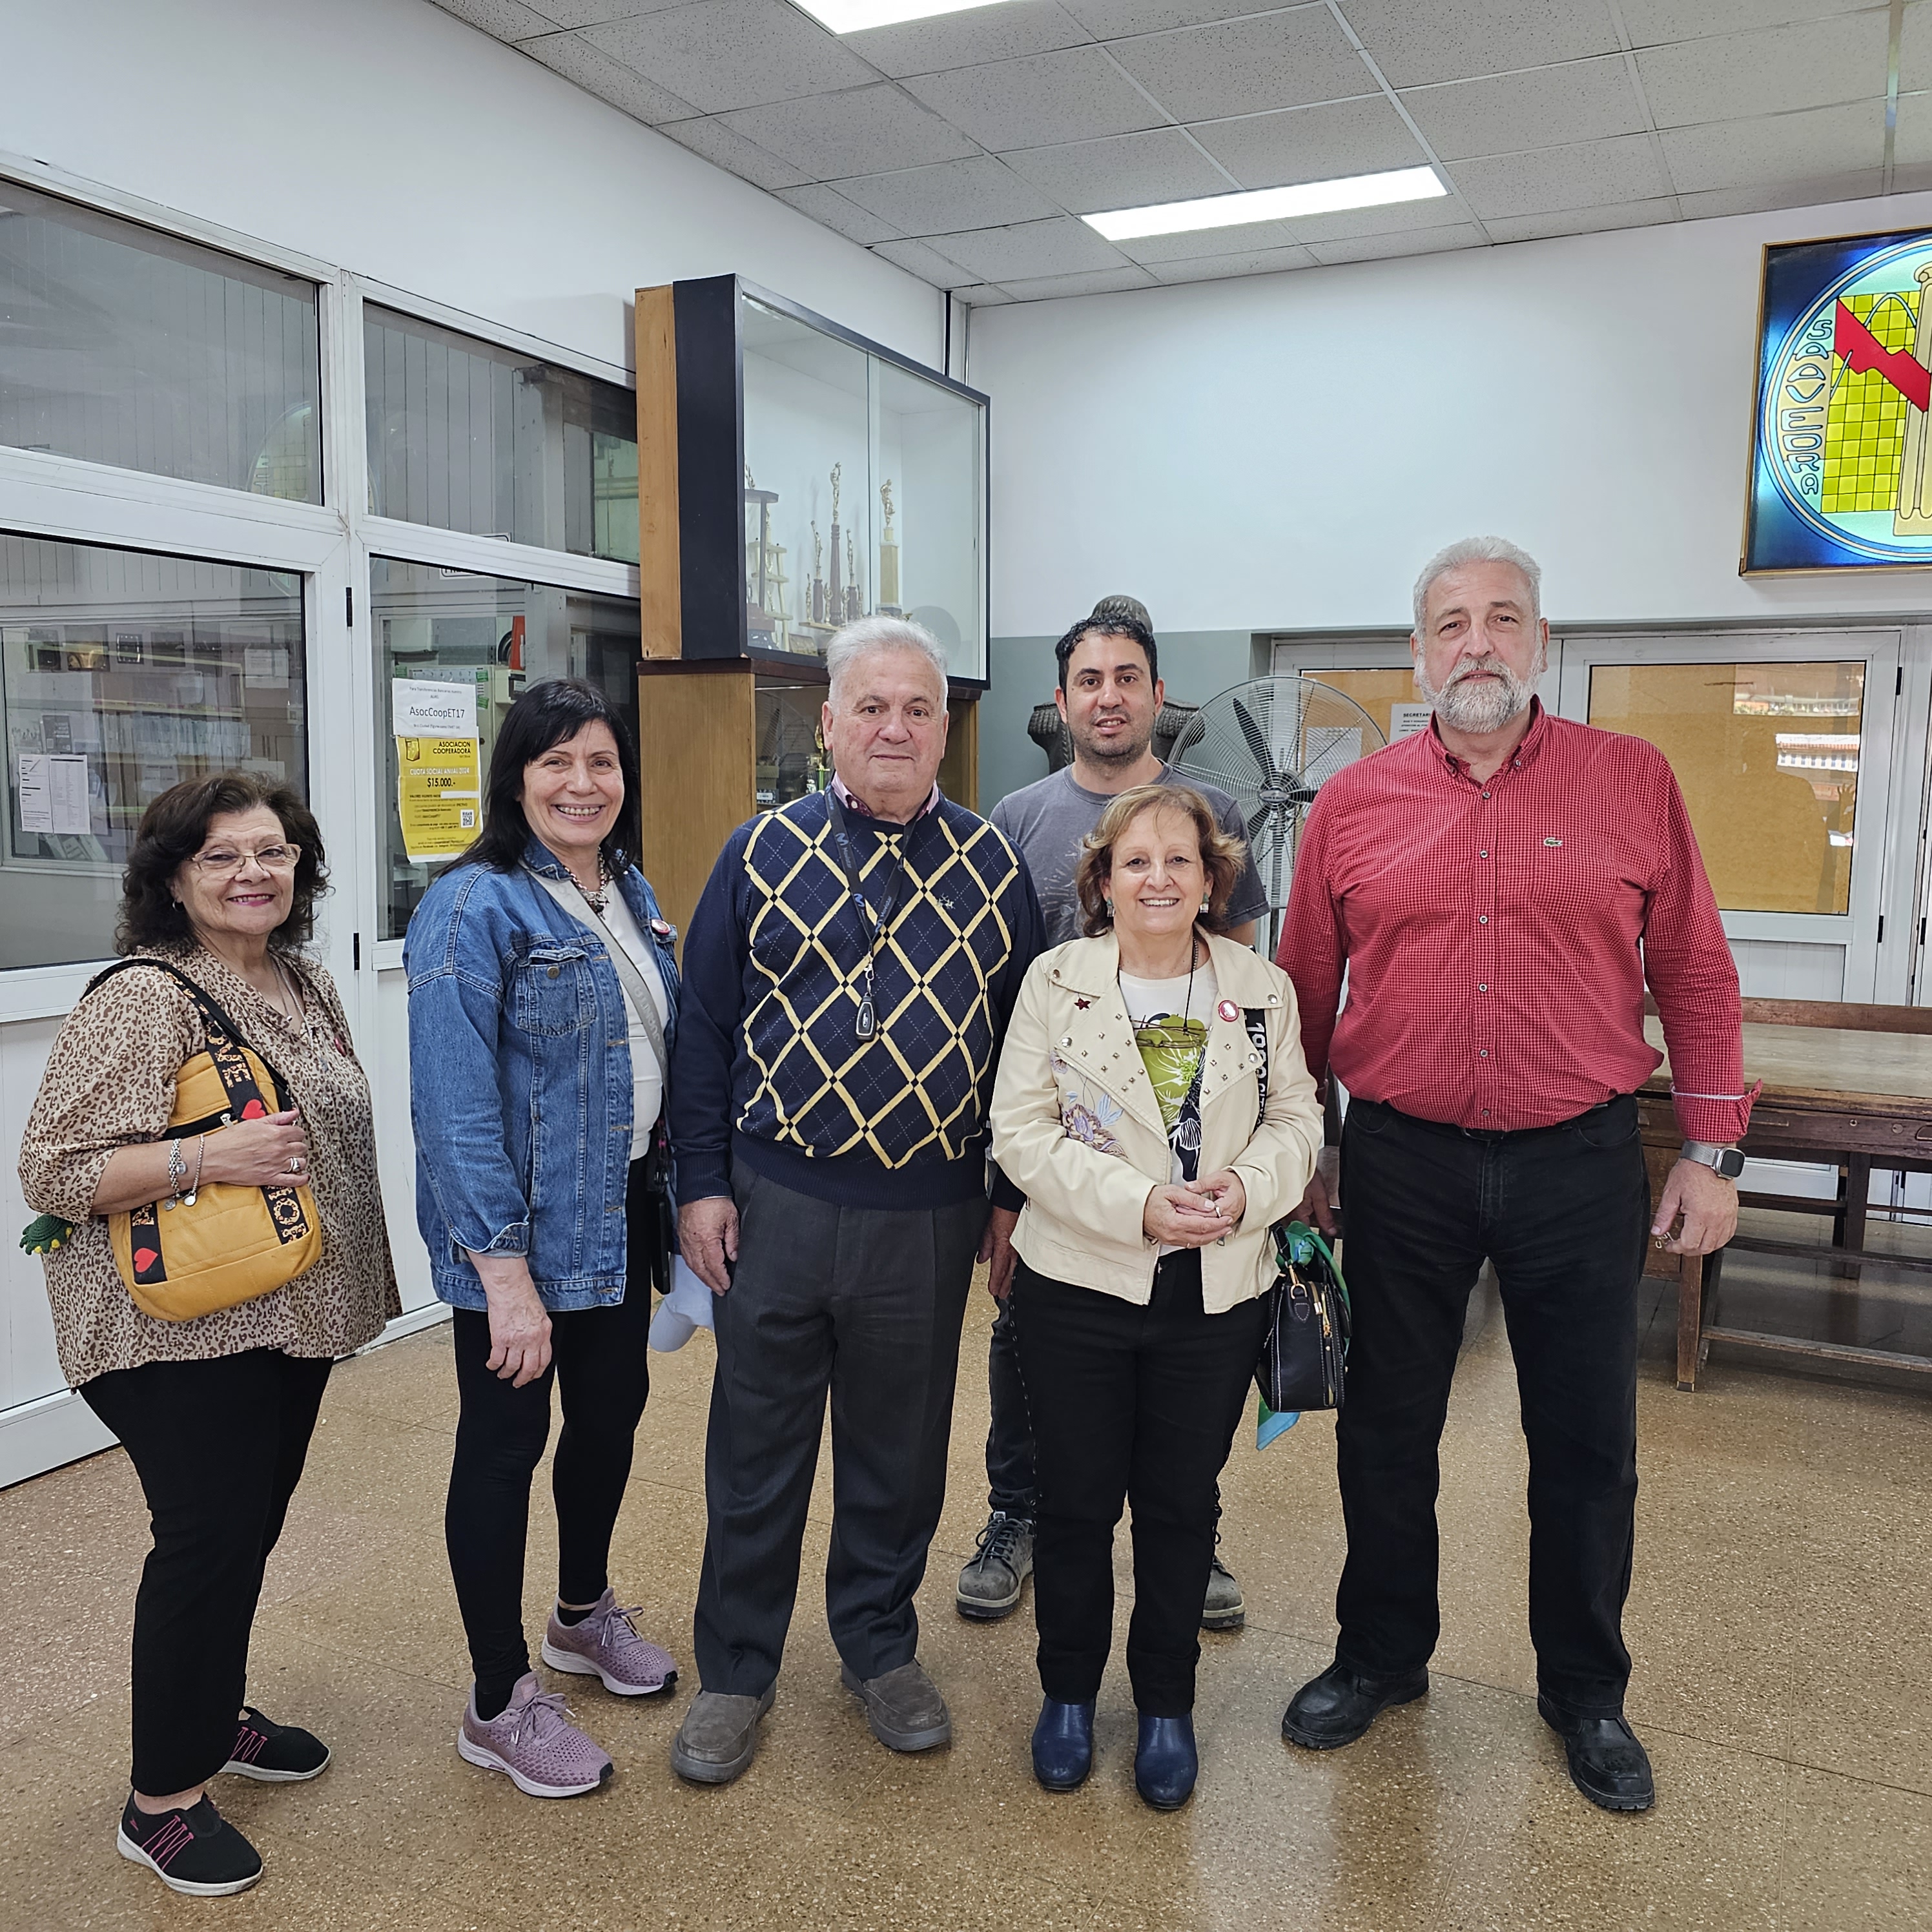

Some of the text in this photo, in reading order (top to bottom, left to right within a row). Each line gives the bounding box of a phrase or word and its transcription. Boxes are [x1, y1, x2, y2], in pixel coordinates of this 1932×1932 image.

[1781, 319, 1833, 495] SAAVEDRA
[409, 706, 465, 719] AsocCoopET17
[880, 896, 892, 917] Movistar
[205, 1021, 252, 1089] OVE
